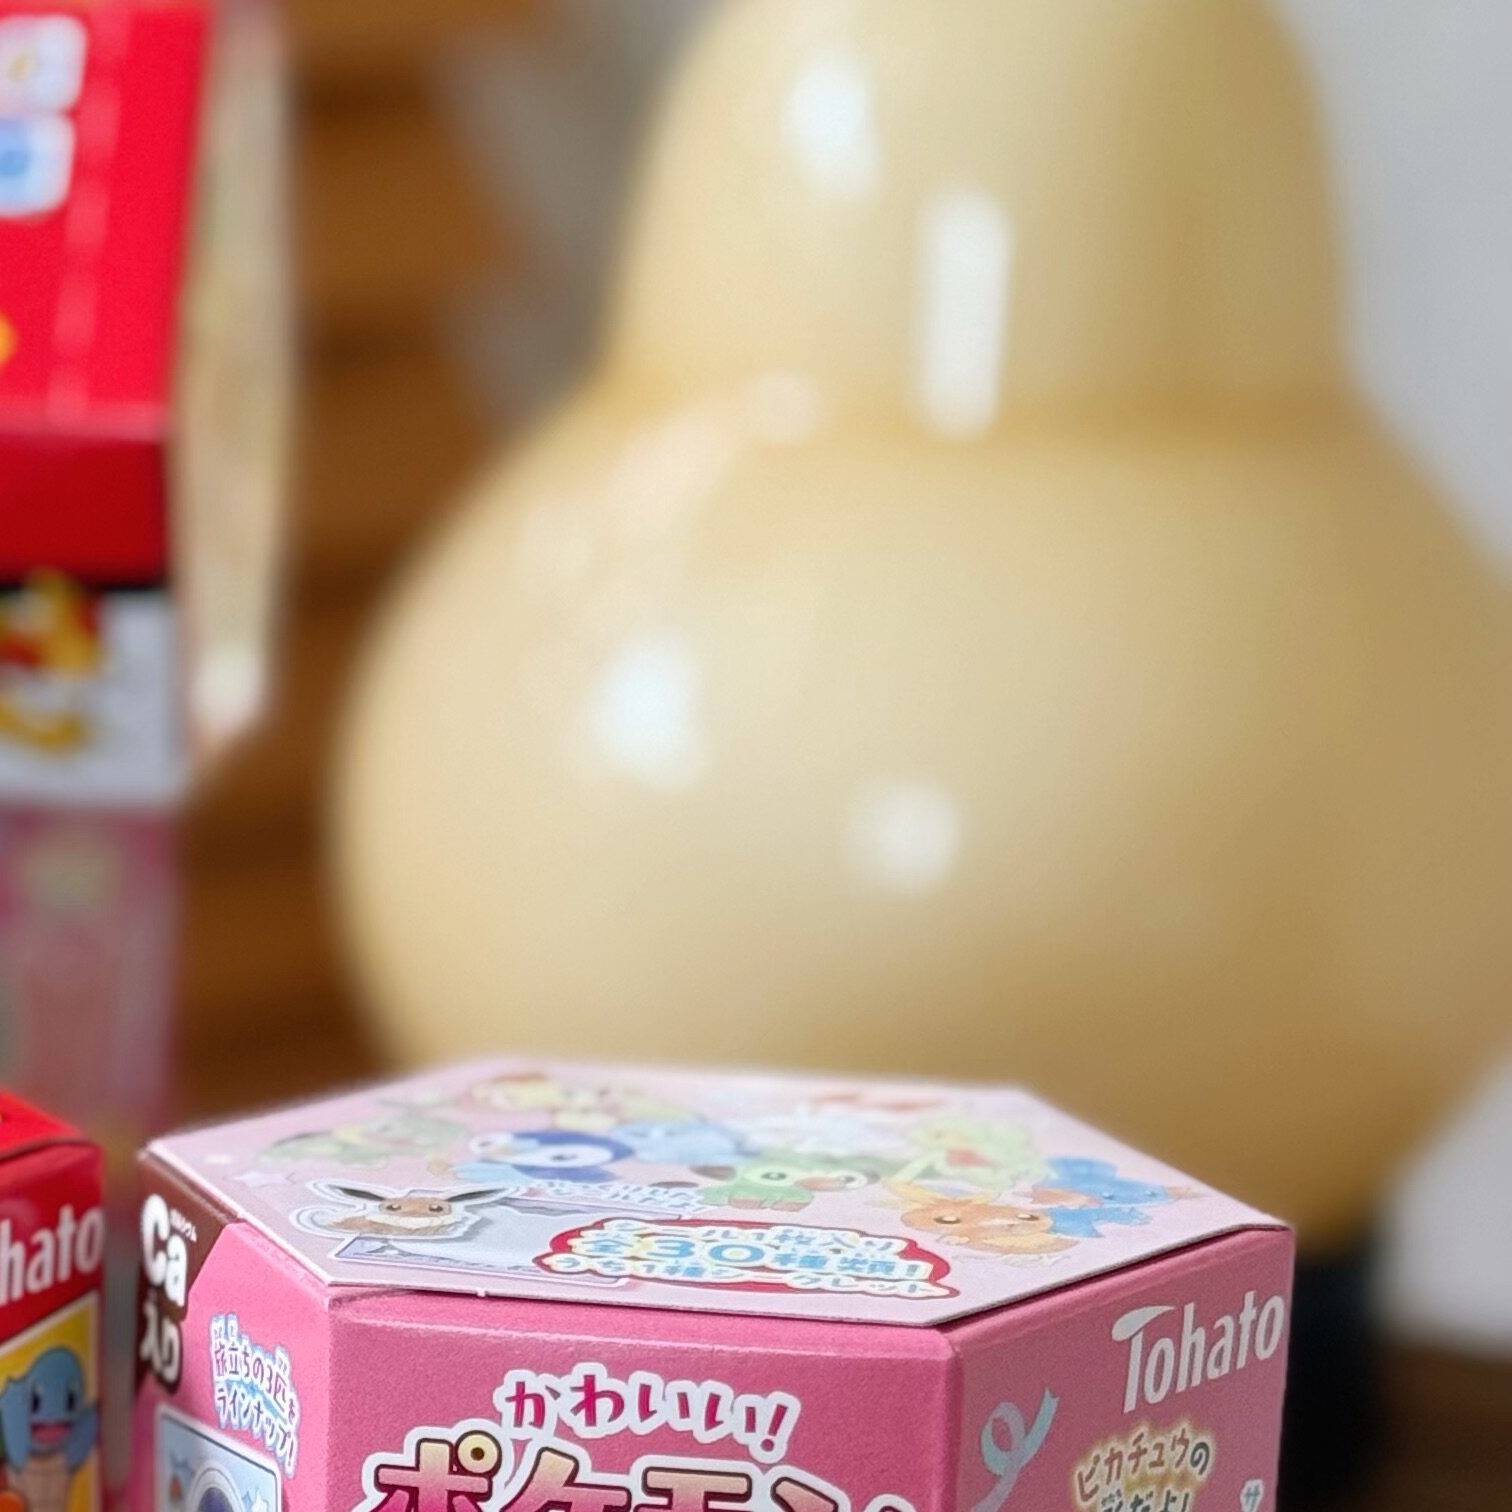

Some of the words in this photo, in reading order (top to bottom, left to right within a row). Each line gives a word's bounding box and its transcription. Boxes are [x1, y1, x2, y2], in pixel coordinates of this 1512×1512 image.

[142, 1194, 187, 1306] Ca
[1112, 1294, 1285, 1413] Tohato
[504, 1373, 789, 1452] かわいい!
[1077, 1427, 1210, 1502] ピカチュウの
